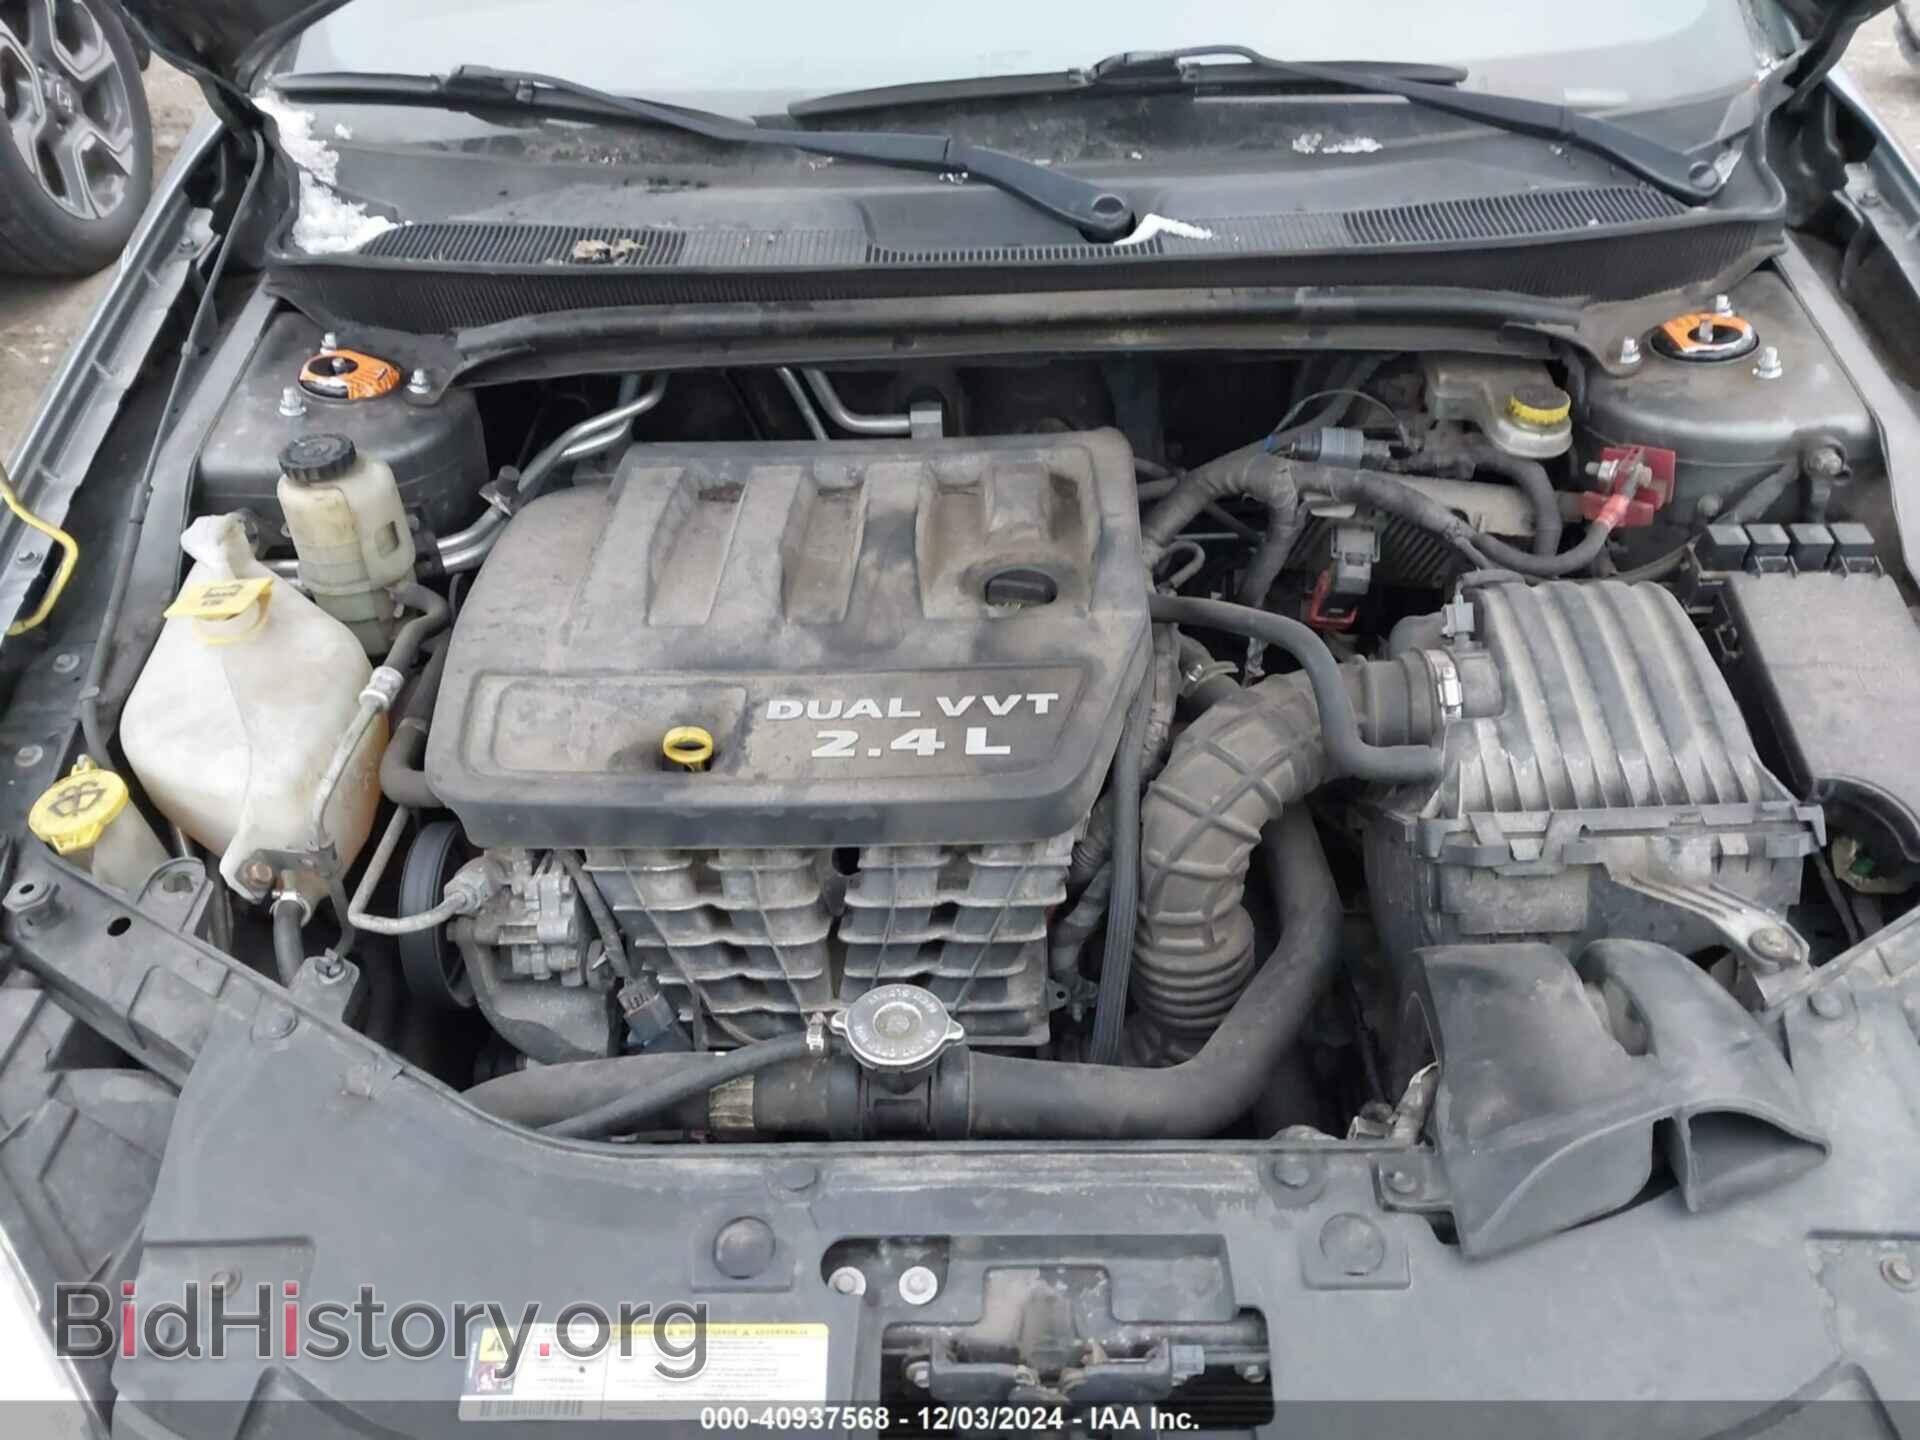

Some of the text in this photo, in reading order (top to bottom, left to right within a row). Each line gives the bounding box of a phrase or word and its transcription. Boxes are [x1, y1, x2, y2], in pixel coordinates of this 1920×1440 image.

[766, 693, 1060, 720] DUAL VVT
[812, 727, 1011, 757] 2.4 L
